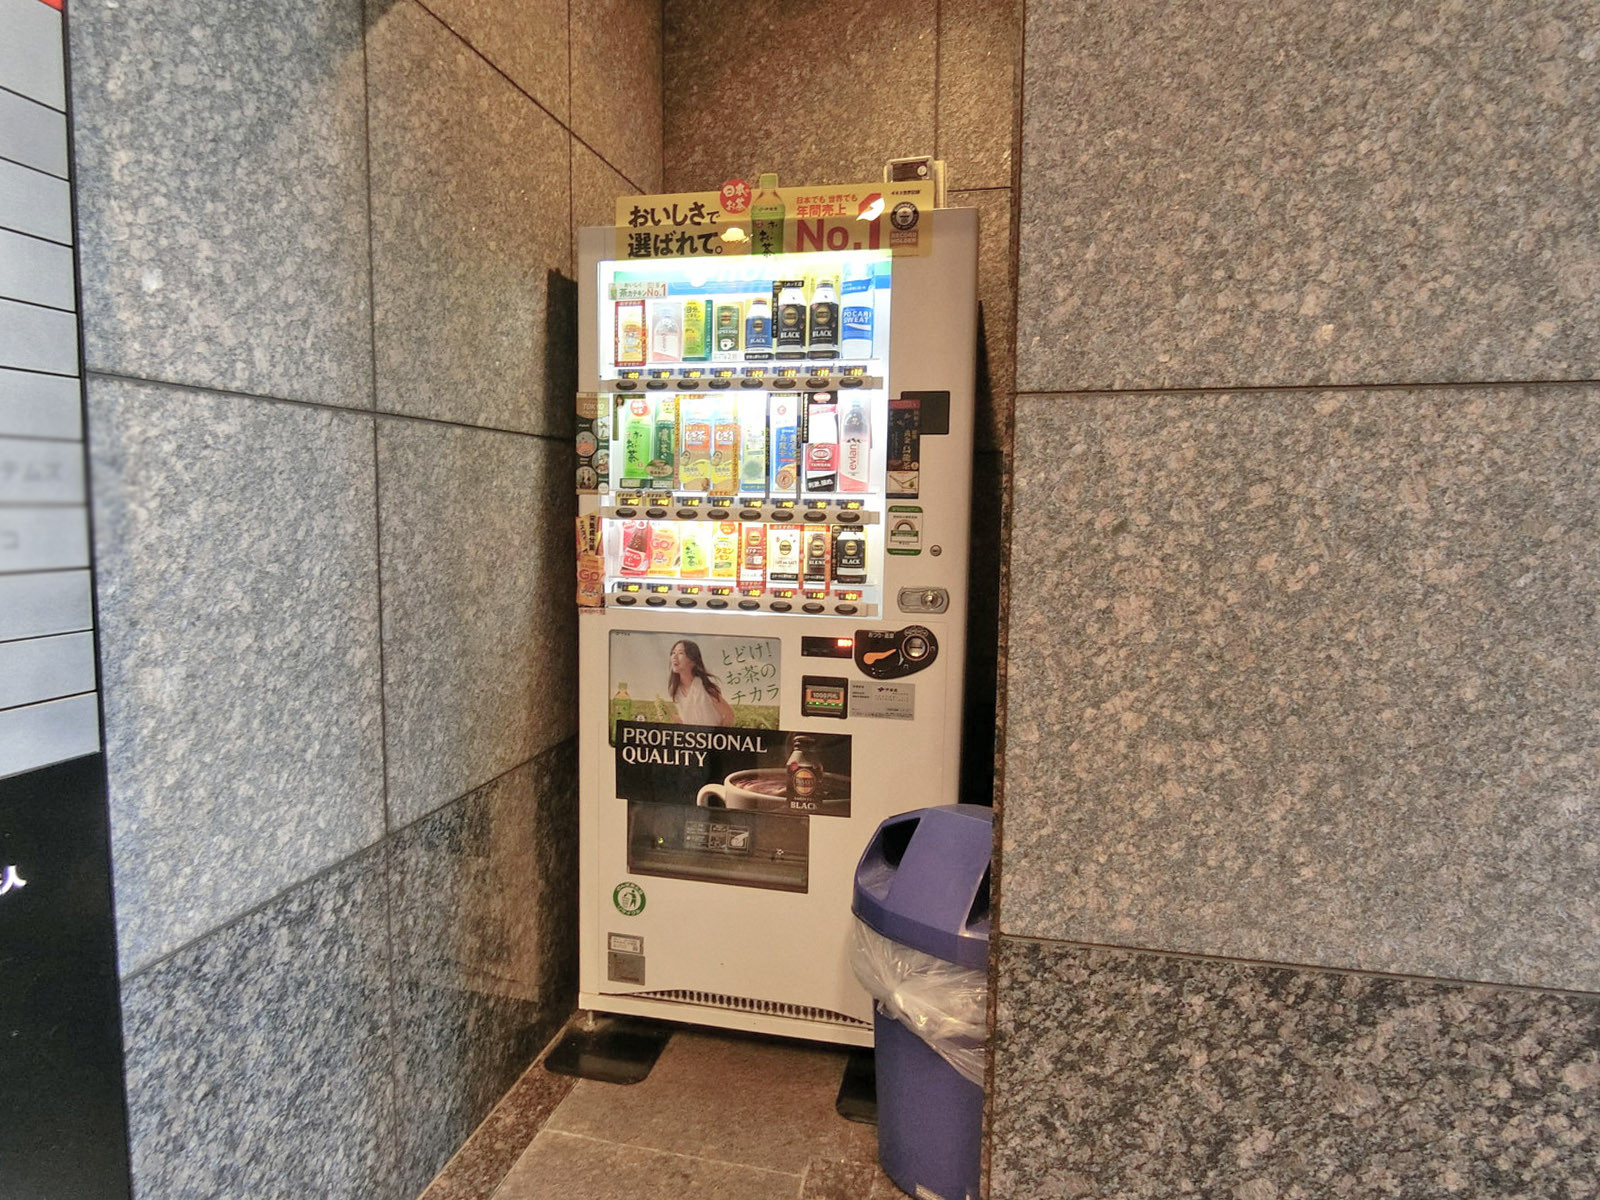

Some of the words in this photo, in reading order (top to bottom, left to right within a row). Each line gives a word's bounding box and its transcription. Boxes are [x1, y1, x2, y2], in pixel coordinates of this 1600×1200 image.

[796, 195, 826, 205] 日本でも
[828, 193, 858, 204] 世界でも
[796, 203, 847, 217] 年間売上
[627, 201, 720, 228] おいしさで
[796, 193, 881, 252] No.1
[627, 230, 723, 258] 選ばれて。
[843, 310, 872, 318] POCARI
[780, 331, 800, 339] BLACK
[812, 329, 832, 338] BLACK
[847, 443, 858, 471] evian
[721, 641, 774, 666] とどけ!
[726, 663, 777, 687] お茶の
[731, 683, 780, 706] チカラ
[622, 727, 768, 754] PROFESSIONAL
[622, 746, 708, 768] QUALITY
